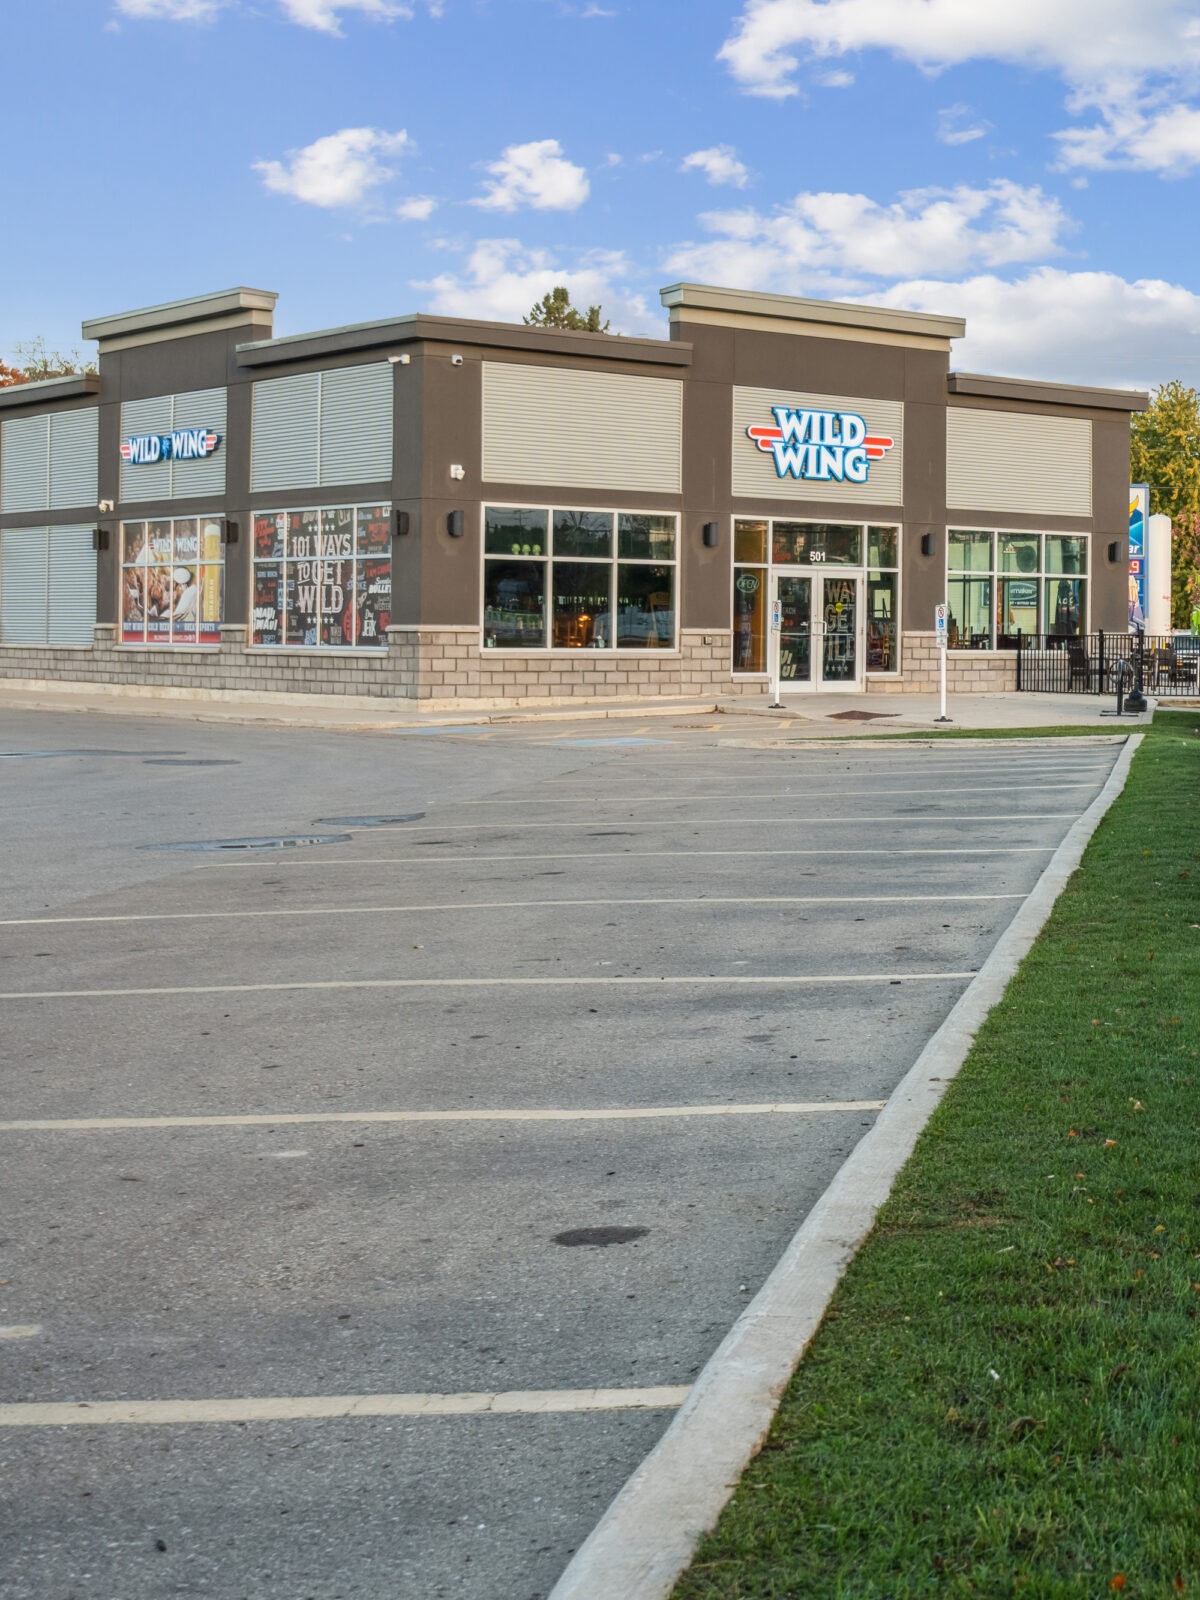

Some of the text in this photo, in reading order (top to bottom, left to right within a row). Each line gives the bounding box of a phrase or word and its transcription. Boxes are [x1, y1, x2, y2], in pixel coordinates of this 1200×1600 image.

[773, 407, 866, 447] WILD
[128, 429, 207, 463] WILD WING
[771, 442, 869, 482] WING
[153, 537, 198, 552] WILD WING
[292, 536, 310, 557] 101
[313, 533, 352, 556] WAYS
[810, 552, 826, 561] 501
[311, 560, 345, 584] GET
